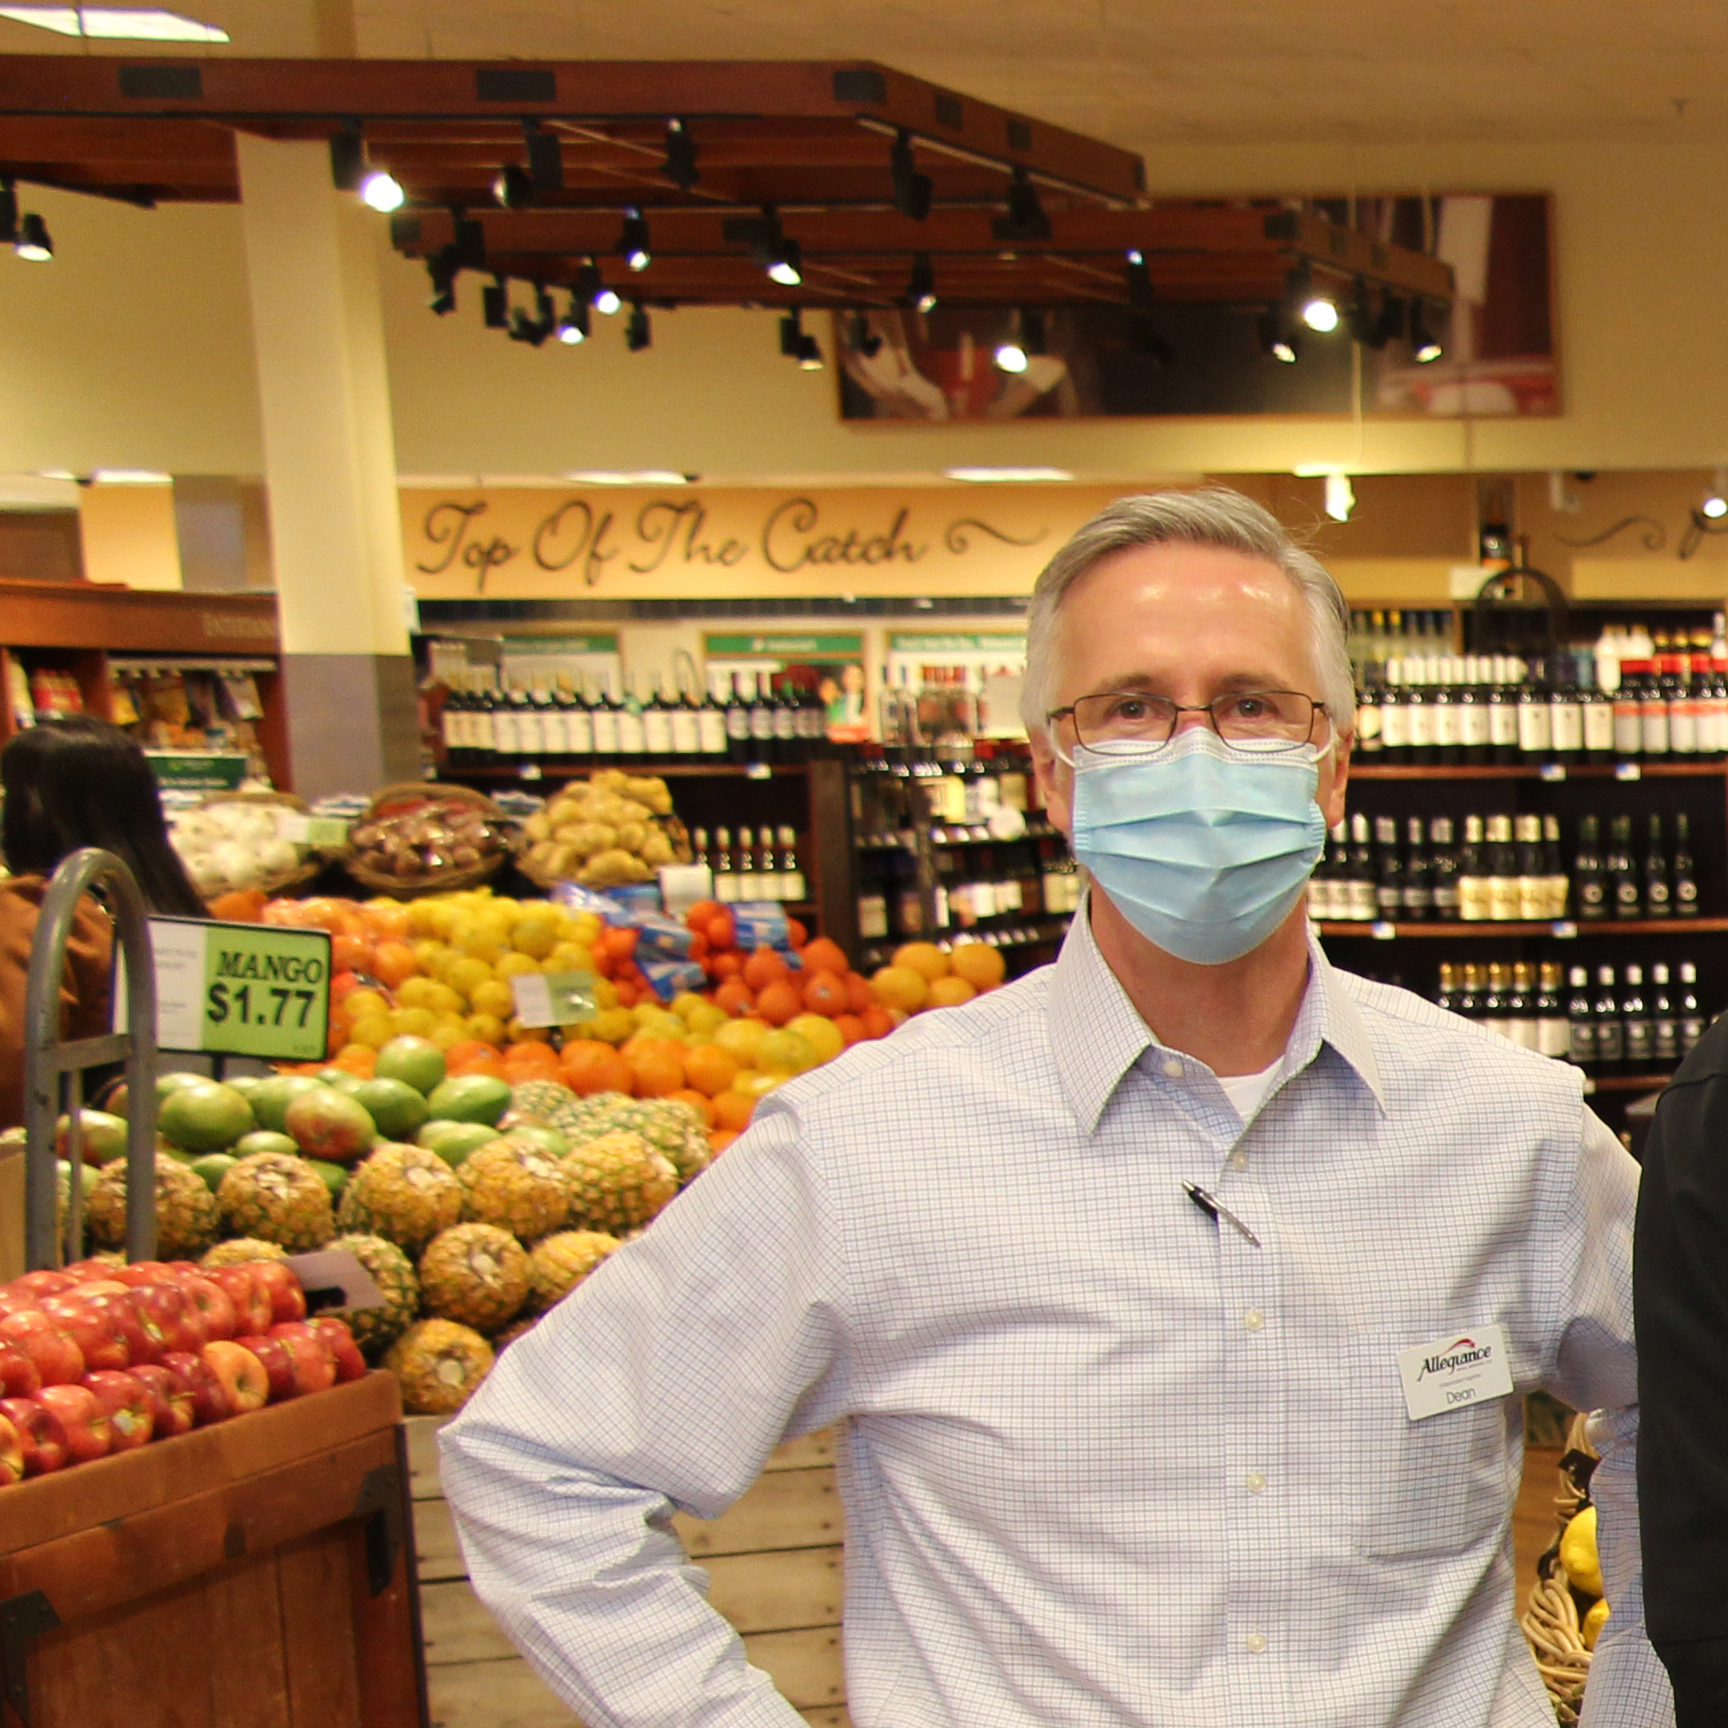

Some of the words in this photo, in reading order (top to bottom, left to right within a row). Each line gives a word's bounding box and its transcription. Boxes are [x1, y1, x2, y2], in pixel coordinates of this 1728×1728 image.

[416, 501, 518, 590] Top
[533, 499, 622, 586] Of
[628, 499, 748, 574] The
[762, 496, 928, 574] Catch
[216, 951, 323, 984] MANGO
[207, 982, 317, 1028] $1.77
[1416, 1345, 1492, 1382] Allegiance
[1446, 1387, 1476, 1404] Dean
